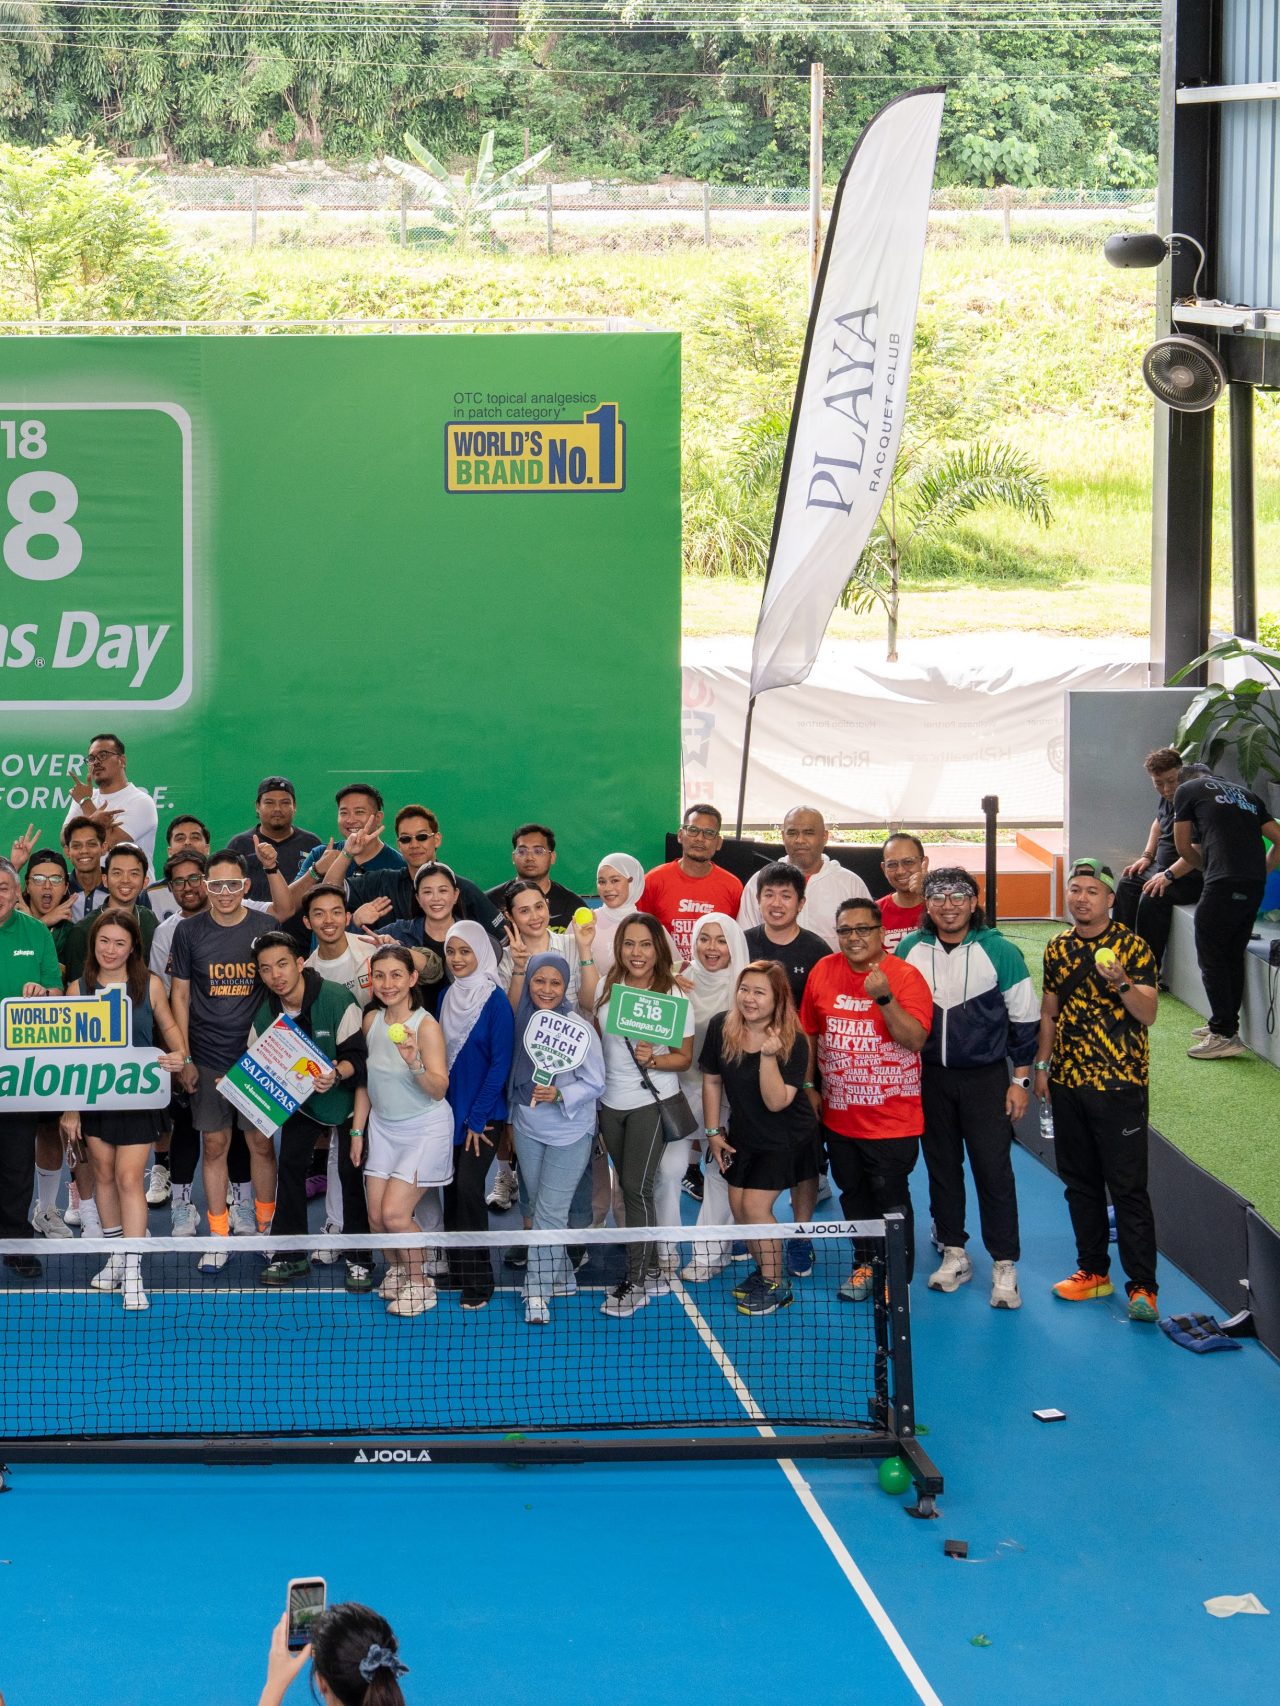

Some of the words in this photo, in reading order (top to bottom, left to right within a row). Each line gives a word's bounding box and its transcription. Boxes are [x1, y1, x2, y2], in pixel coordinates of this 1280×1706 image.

[454, 393, 482, 404] OTC
[487, 392, 526, 406] topical
[531, 392, 596, 406] analgesics
[806, 301, 878, 516] PLAYA
[454, 407, 464, 417] in
[468, 407, 502, 420] patch
[869, 395, 894, 492] RACQUET
[887, 333, 900, 386] CLUB
[1, 420, 47, 459] 18
[453, 431, 542, 456] WORLD'S
[586, 405, 616, 483] 1
[456, 460, 543, 484] BRAND
[52, 611, 170, 687] Day
[209, 963, 256, 979] ICONS
[639, 997, 651, 1005] May
[11, 1007, 71, 1025] WORLD'S
[101, 989, 121, 1042] 1
[633, 1003, 662, 1021] 5.18
[12, 1026, 71, 1044] BRAND
[540, 1016, 585, 1042] PICKLE
[655, 1024, 671, 1036] Day
[535, 1030, 577, 1056] PATCH
[808, 1224, 858, 1234] JOOLA
[369, 1449, 432, 1462] JOOLA
